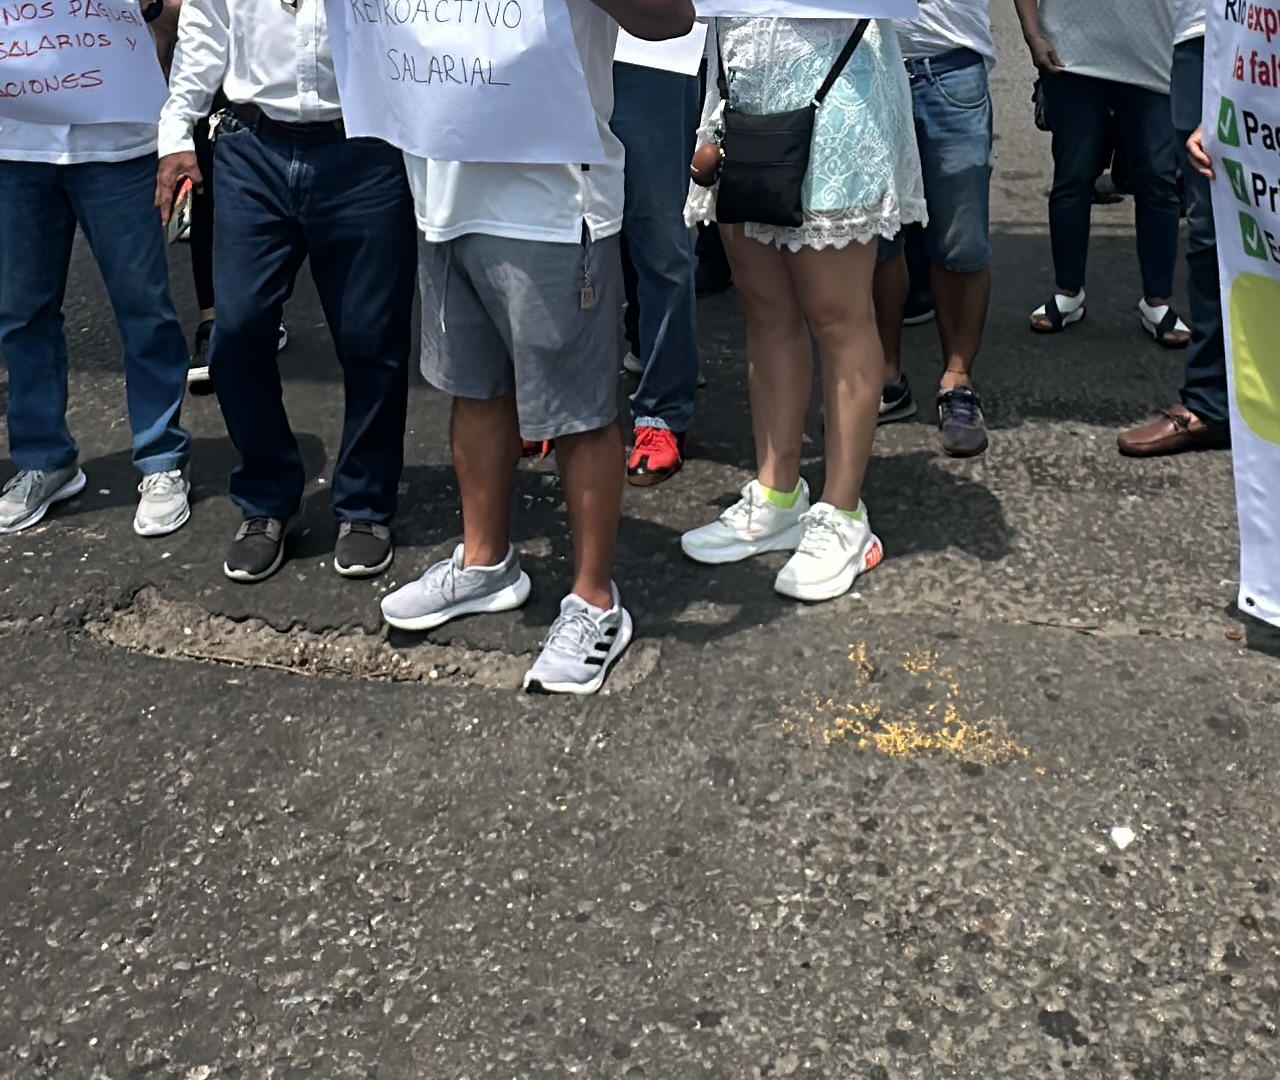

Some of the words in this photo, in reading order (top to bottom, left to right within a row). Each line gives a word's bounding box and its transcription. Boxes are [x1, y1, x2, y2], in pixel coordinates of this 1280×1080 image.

[2, 1, 53, 26] NOS
[386, 48, 511, 86] SALARIAL
[1233, 46, 1245, 81] la
